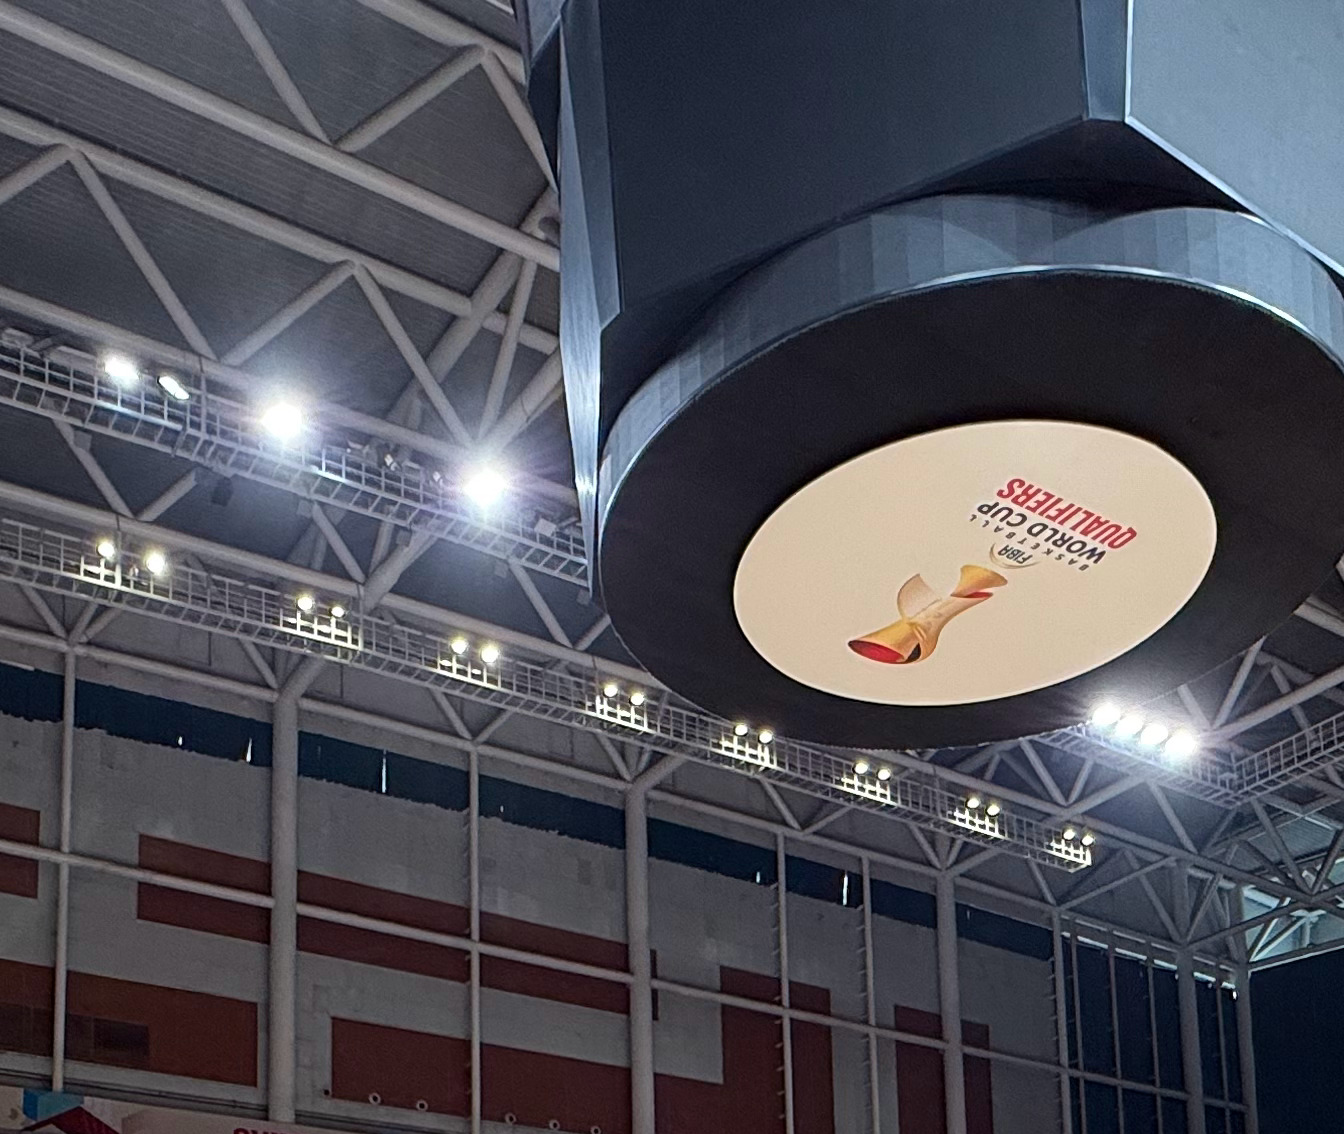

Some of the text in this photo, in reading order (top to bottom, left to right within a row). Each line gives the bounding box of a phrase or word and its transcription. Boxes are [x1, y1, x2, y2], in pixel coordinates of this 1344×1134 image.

[969, 514, 1089, 571] BASKETBALL
[977, 502, 1108, 564] WORLD CUP
[996, 478, 1137, 549] QUALIFIERS
[997, 545, 1034, 565] FIBA
